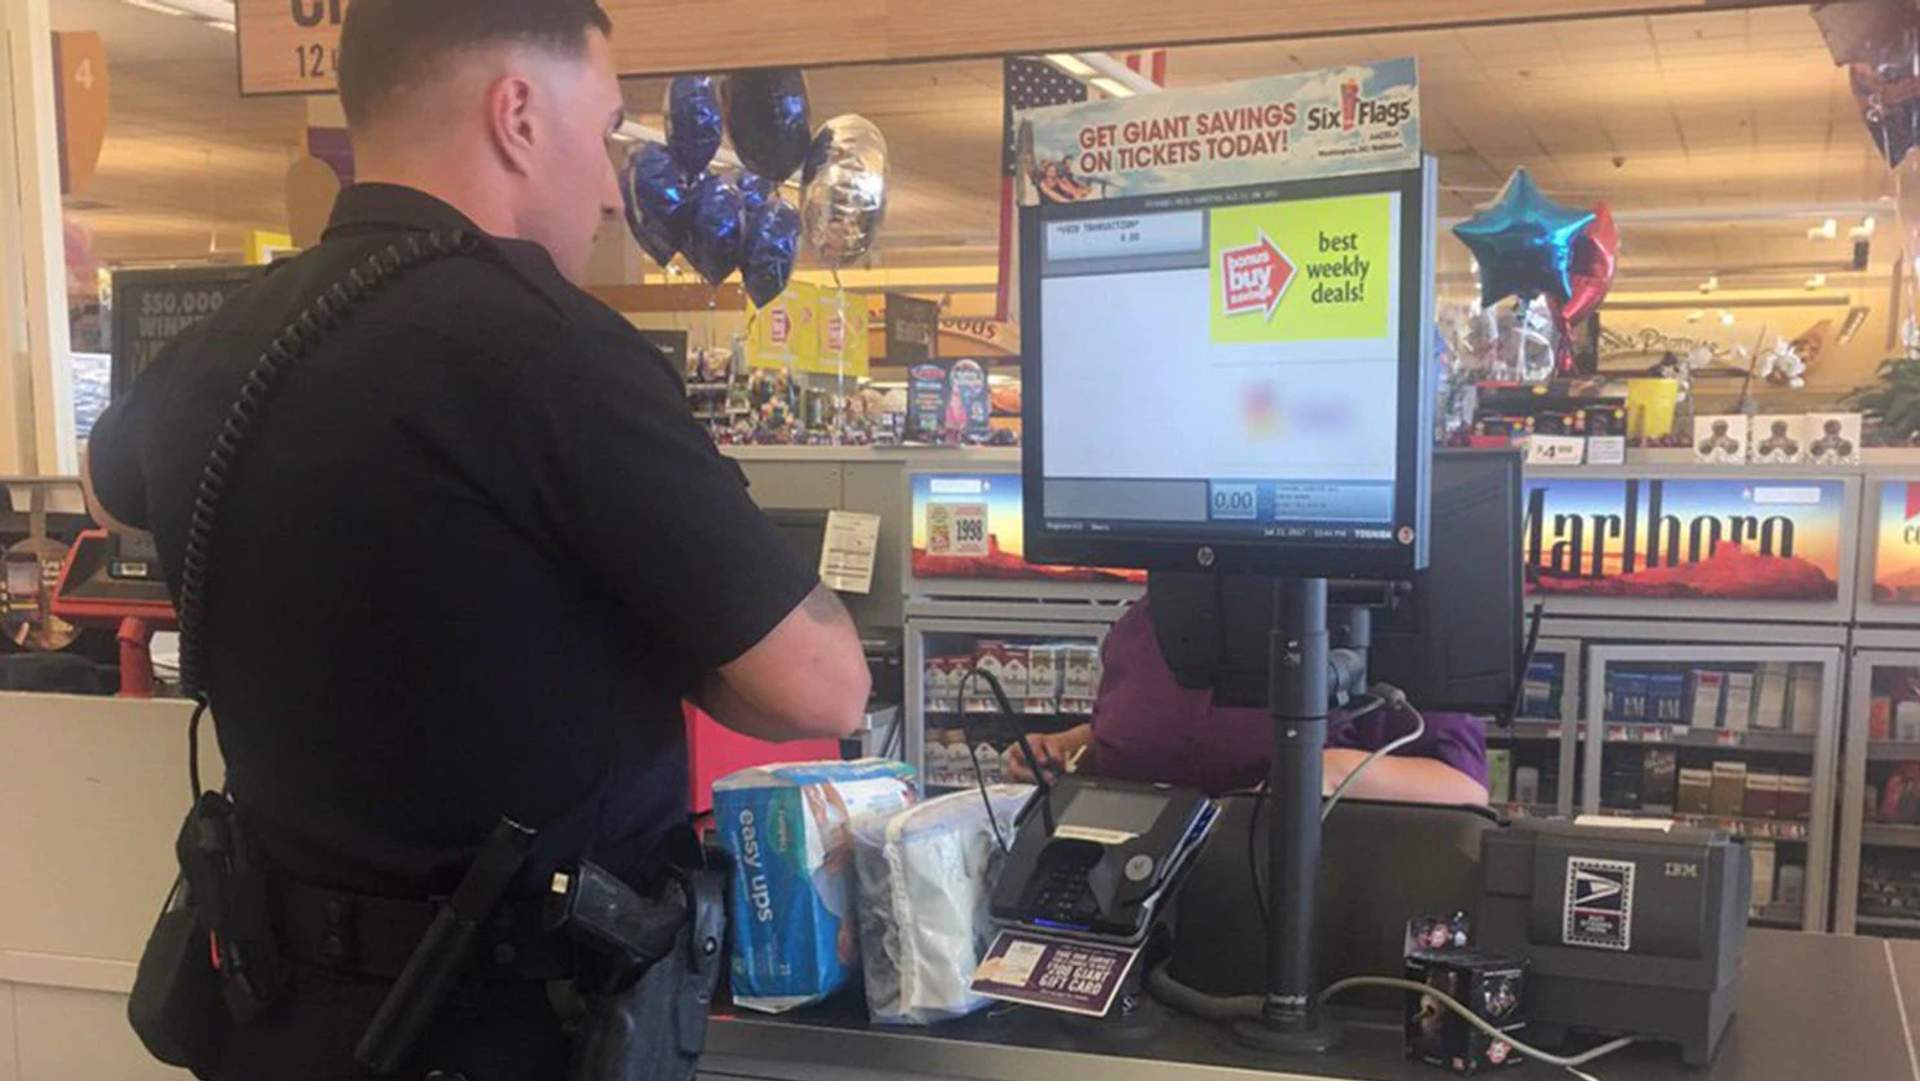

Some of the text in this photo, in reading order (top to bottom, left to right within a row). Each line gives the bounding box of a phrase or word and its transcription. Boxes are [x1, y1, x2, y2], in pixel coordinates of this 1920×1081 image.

[75, 58, 95, 89] 4
[295, 43, 324, 78] 12
[1079, 102, 1297, 149] GET GIANT SAVINGS
[1307, 98, 1412, 131] Six Flags
[1080, 150, 1112, 173] ON
[1118, 141, 1201, 169] TICKETS
[1205, 130, 1289, 160] TODAY!
[1318, 231, 1359, 253] best
[1306, 255, 1370, 281] weekly
[1311, 281, 1364, 304] deals!
[1214, 491, 1253, 509] 0.00
[956, 518, 984, 541] 1998
[739, 809, 762, 868] easy
[1665, 862, 1698, 877] IBM
[752, 874, 773, 922] ups
